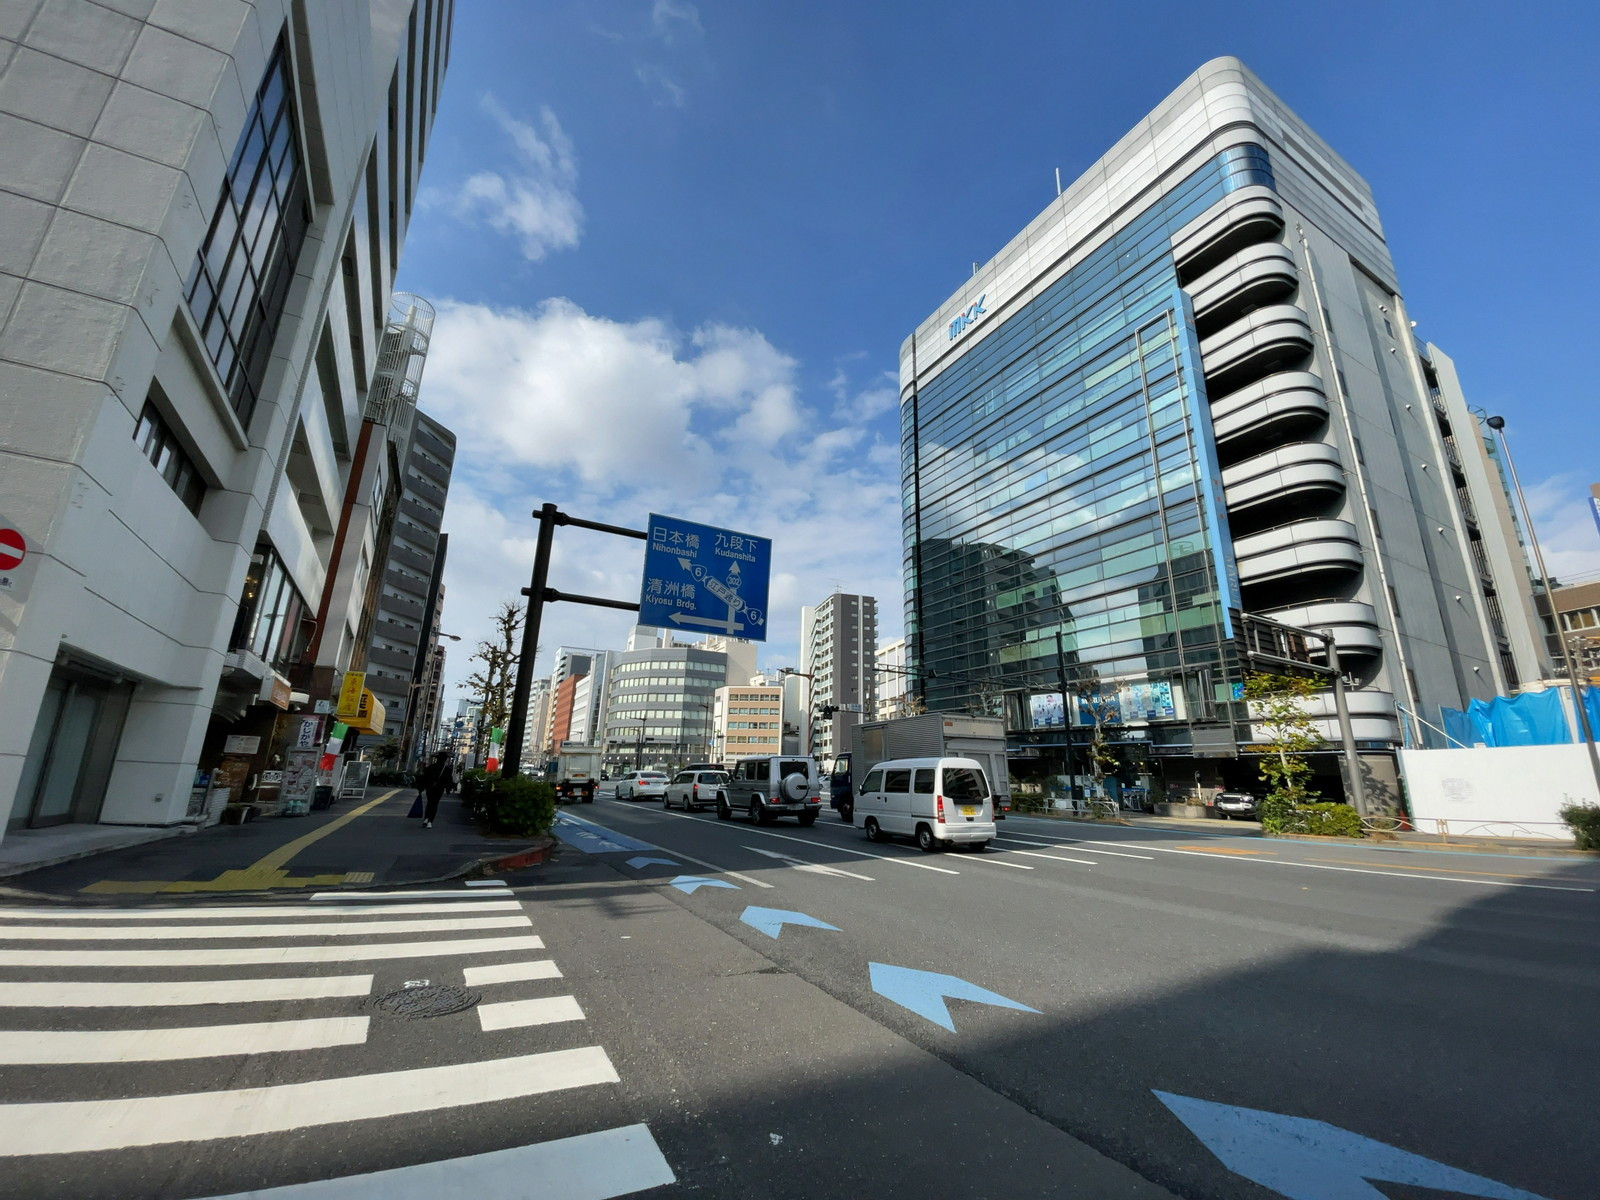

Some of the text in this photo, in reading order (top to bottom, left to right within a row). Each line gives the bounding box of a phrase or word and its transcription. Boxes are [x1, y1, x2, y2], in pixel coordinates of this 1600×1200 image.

[652, 526, 701, 549] 日本橋
[714, 533, 758, 553] 九段下
[652, 542, 698, 558] Nihonbashi
[714, 547, 756, 563] Kudanshita
[694, 567, 702, 577] 6
[728, 576, 740, 585] 302
[646, 578, 696, 600] 清洲橋
[708, 580, 741, 608] 江戸通り
[645, 594, 697, 610] Kiyosu Brdg.
[750, 610, 757, 621] 6
